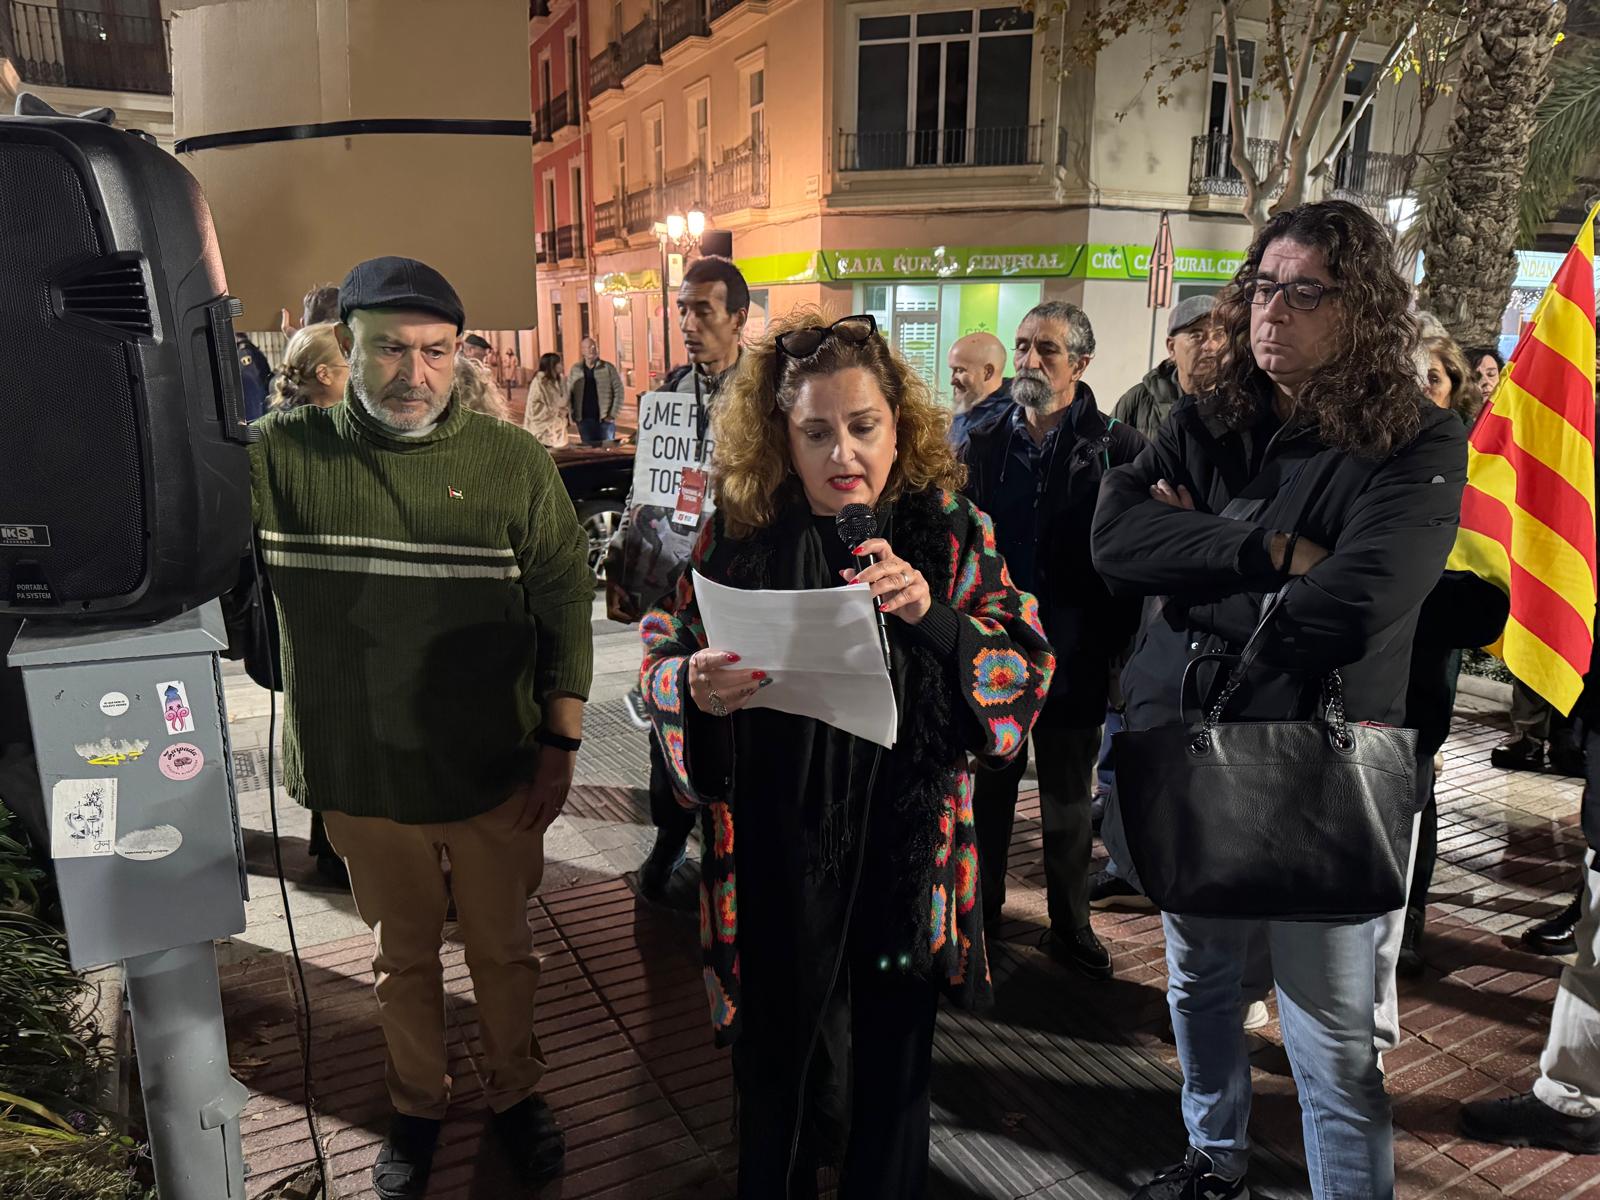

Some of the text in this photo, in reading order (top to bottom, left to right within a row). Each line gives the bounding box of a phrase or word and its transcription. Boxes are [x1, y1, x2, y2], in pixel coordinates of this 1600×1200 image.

[838, 254, 1065, 274] CAJA RURAL CENTRAL
[1091, 253, 1122, 269] CRC
[643, 401, 683, 431] ¿ME
